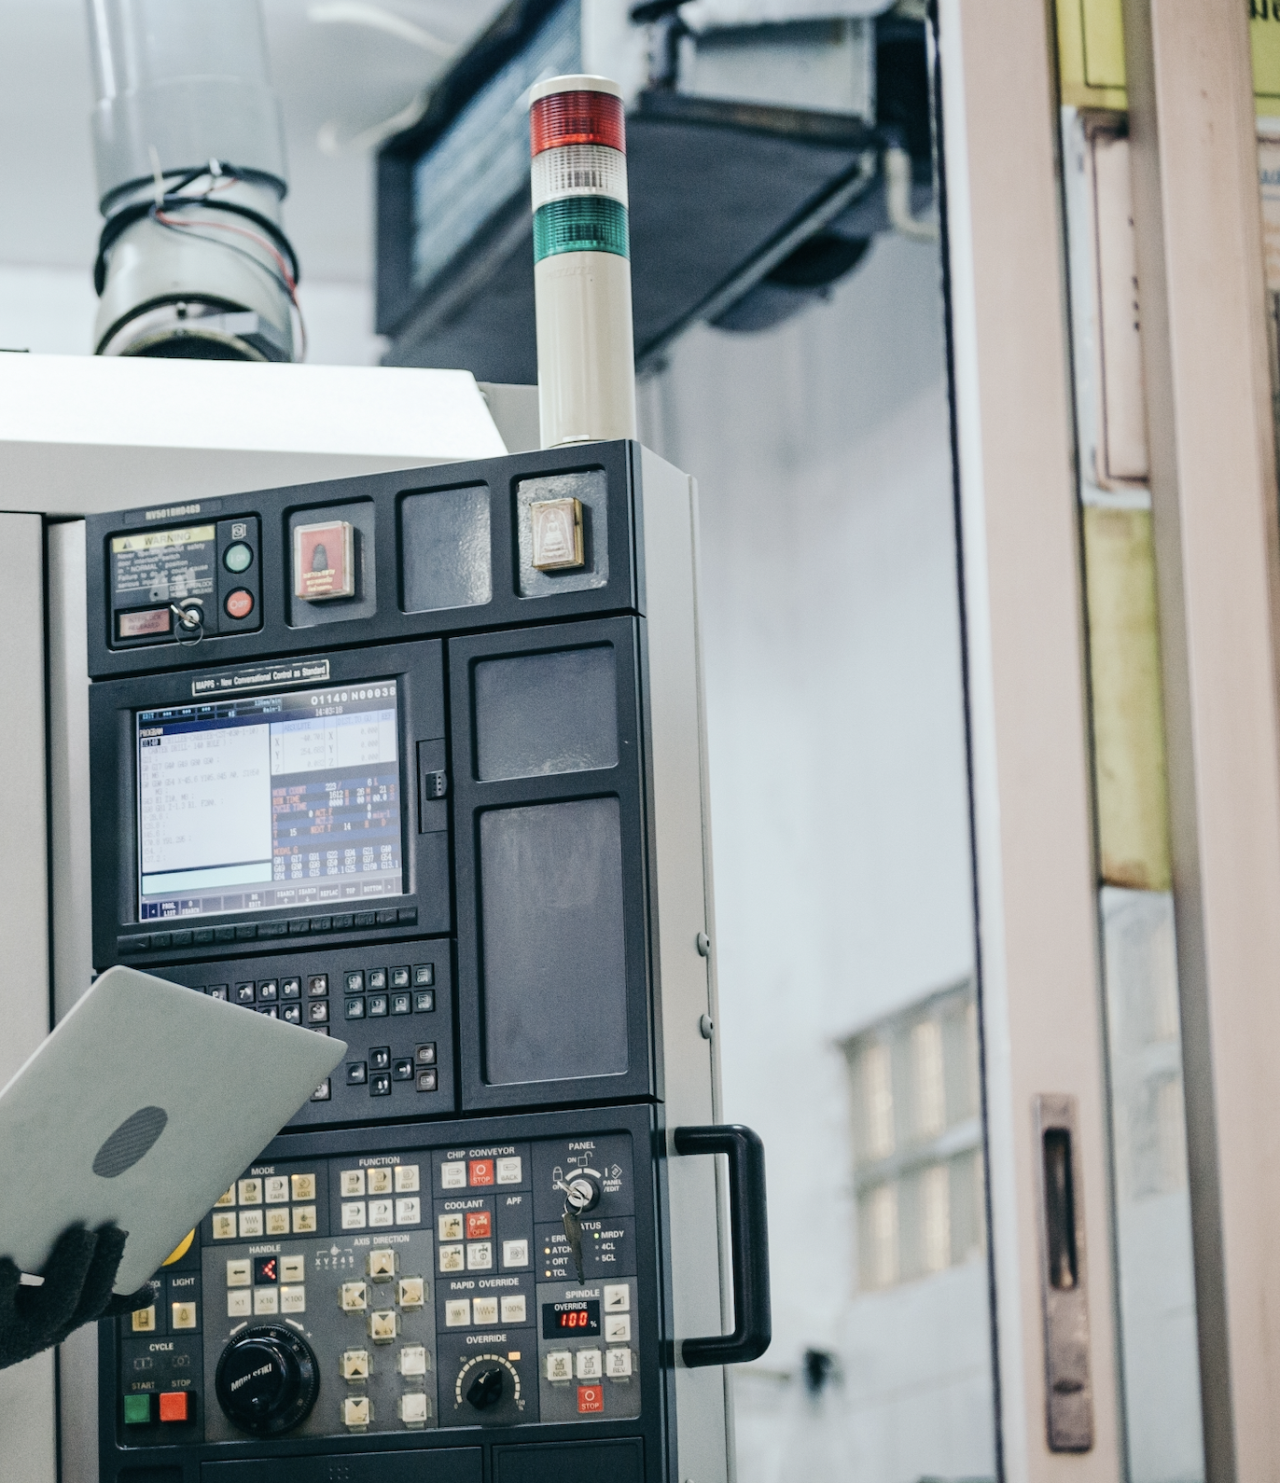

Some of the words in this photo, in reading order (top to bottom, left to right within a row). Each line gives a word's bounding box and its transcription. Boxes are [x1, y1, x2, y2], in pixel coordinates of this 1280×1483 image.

[144, 531, 191, 546] WARNING
[195, 679, 215, 690] MAPPS
[221, 678, 232, 687] New
[233, 672, 271, 685] Conversational
[273, 669, 292, 680] Control
[293, 670, 300, 678] as
[301, 665, 326, 677] Standard
[351, 686, 396, 701] N00038
[140, 727, 163, 738] PROGRAM
[274, 738, 280, 747] X
[328, 731, 334, 740] X
[274, 750, 280, 760] Y
[328, 744, 334, 754] Y
[274, 764, 280, 773] Z
[328, 758, 334, 767] Z
[325, 782, 337, 791] 223
[329, 790, 344, 799] 1612
[379, 785, 387, 794] 21
[289, 827, 297, 837] 15
[343, 822, 351, 831] 14
[298, 887, 317, 895] SEARCH
[320, 889, 339, 897] REPLAC
[345, 887, 356, 895] TOP
[239, 990, 246, 999] 7
[262, 986, 269, 996] 8
[284, 984, 291, 994] 9
[285, 1010, 292, 1019] 6
[568, 1141, 596, 1151] PANEL
[447, 1150, 466, 1160] CHIP
[469, 1146, 515, 1158] CONVEYOR
[358, 1156, 400, 1167] FUNCTION
[251, 1166, 275, 1176] MODE
[444, 1200, 484, 1210] COOLANT
[506, 1197, 522, 1205] APF
[353, 1237, 370, 1246] AXIS
[373, 1234, 410, 1245] DIRECTION
[601, 1230, 624, 1239] MRDY
[249, 1244, 281, 1254] HANDLE
[315, 1258, 321, 1266] X
[552, 1257, 568, 1265] ORT
[601, 1254, 616, 1262] 5CL
[552, 1269, 567, 1277] TCL
[172, 1277, 195, 1287] LIGHT
[450, 1281, 475, 1290] RAPID
[479, 1278, 520, 1288] OVERRIDE
[565, 1289, 600, 1299] SPINDLE
[504, 1305, 523, 1313] 100%
[554, 1301, 587, 1311] OVERRIDE
[561, 1311, 588, 1327] 100
[466, 1334, 507, 1344] OVERRIDE
[149, 1342, 174, 1351] CYCLE
[132, 1381, 155, 1390] START
[172, 1379, 191, 1387] STOP
